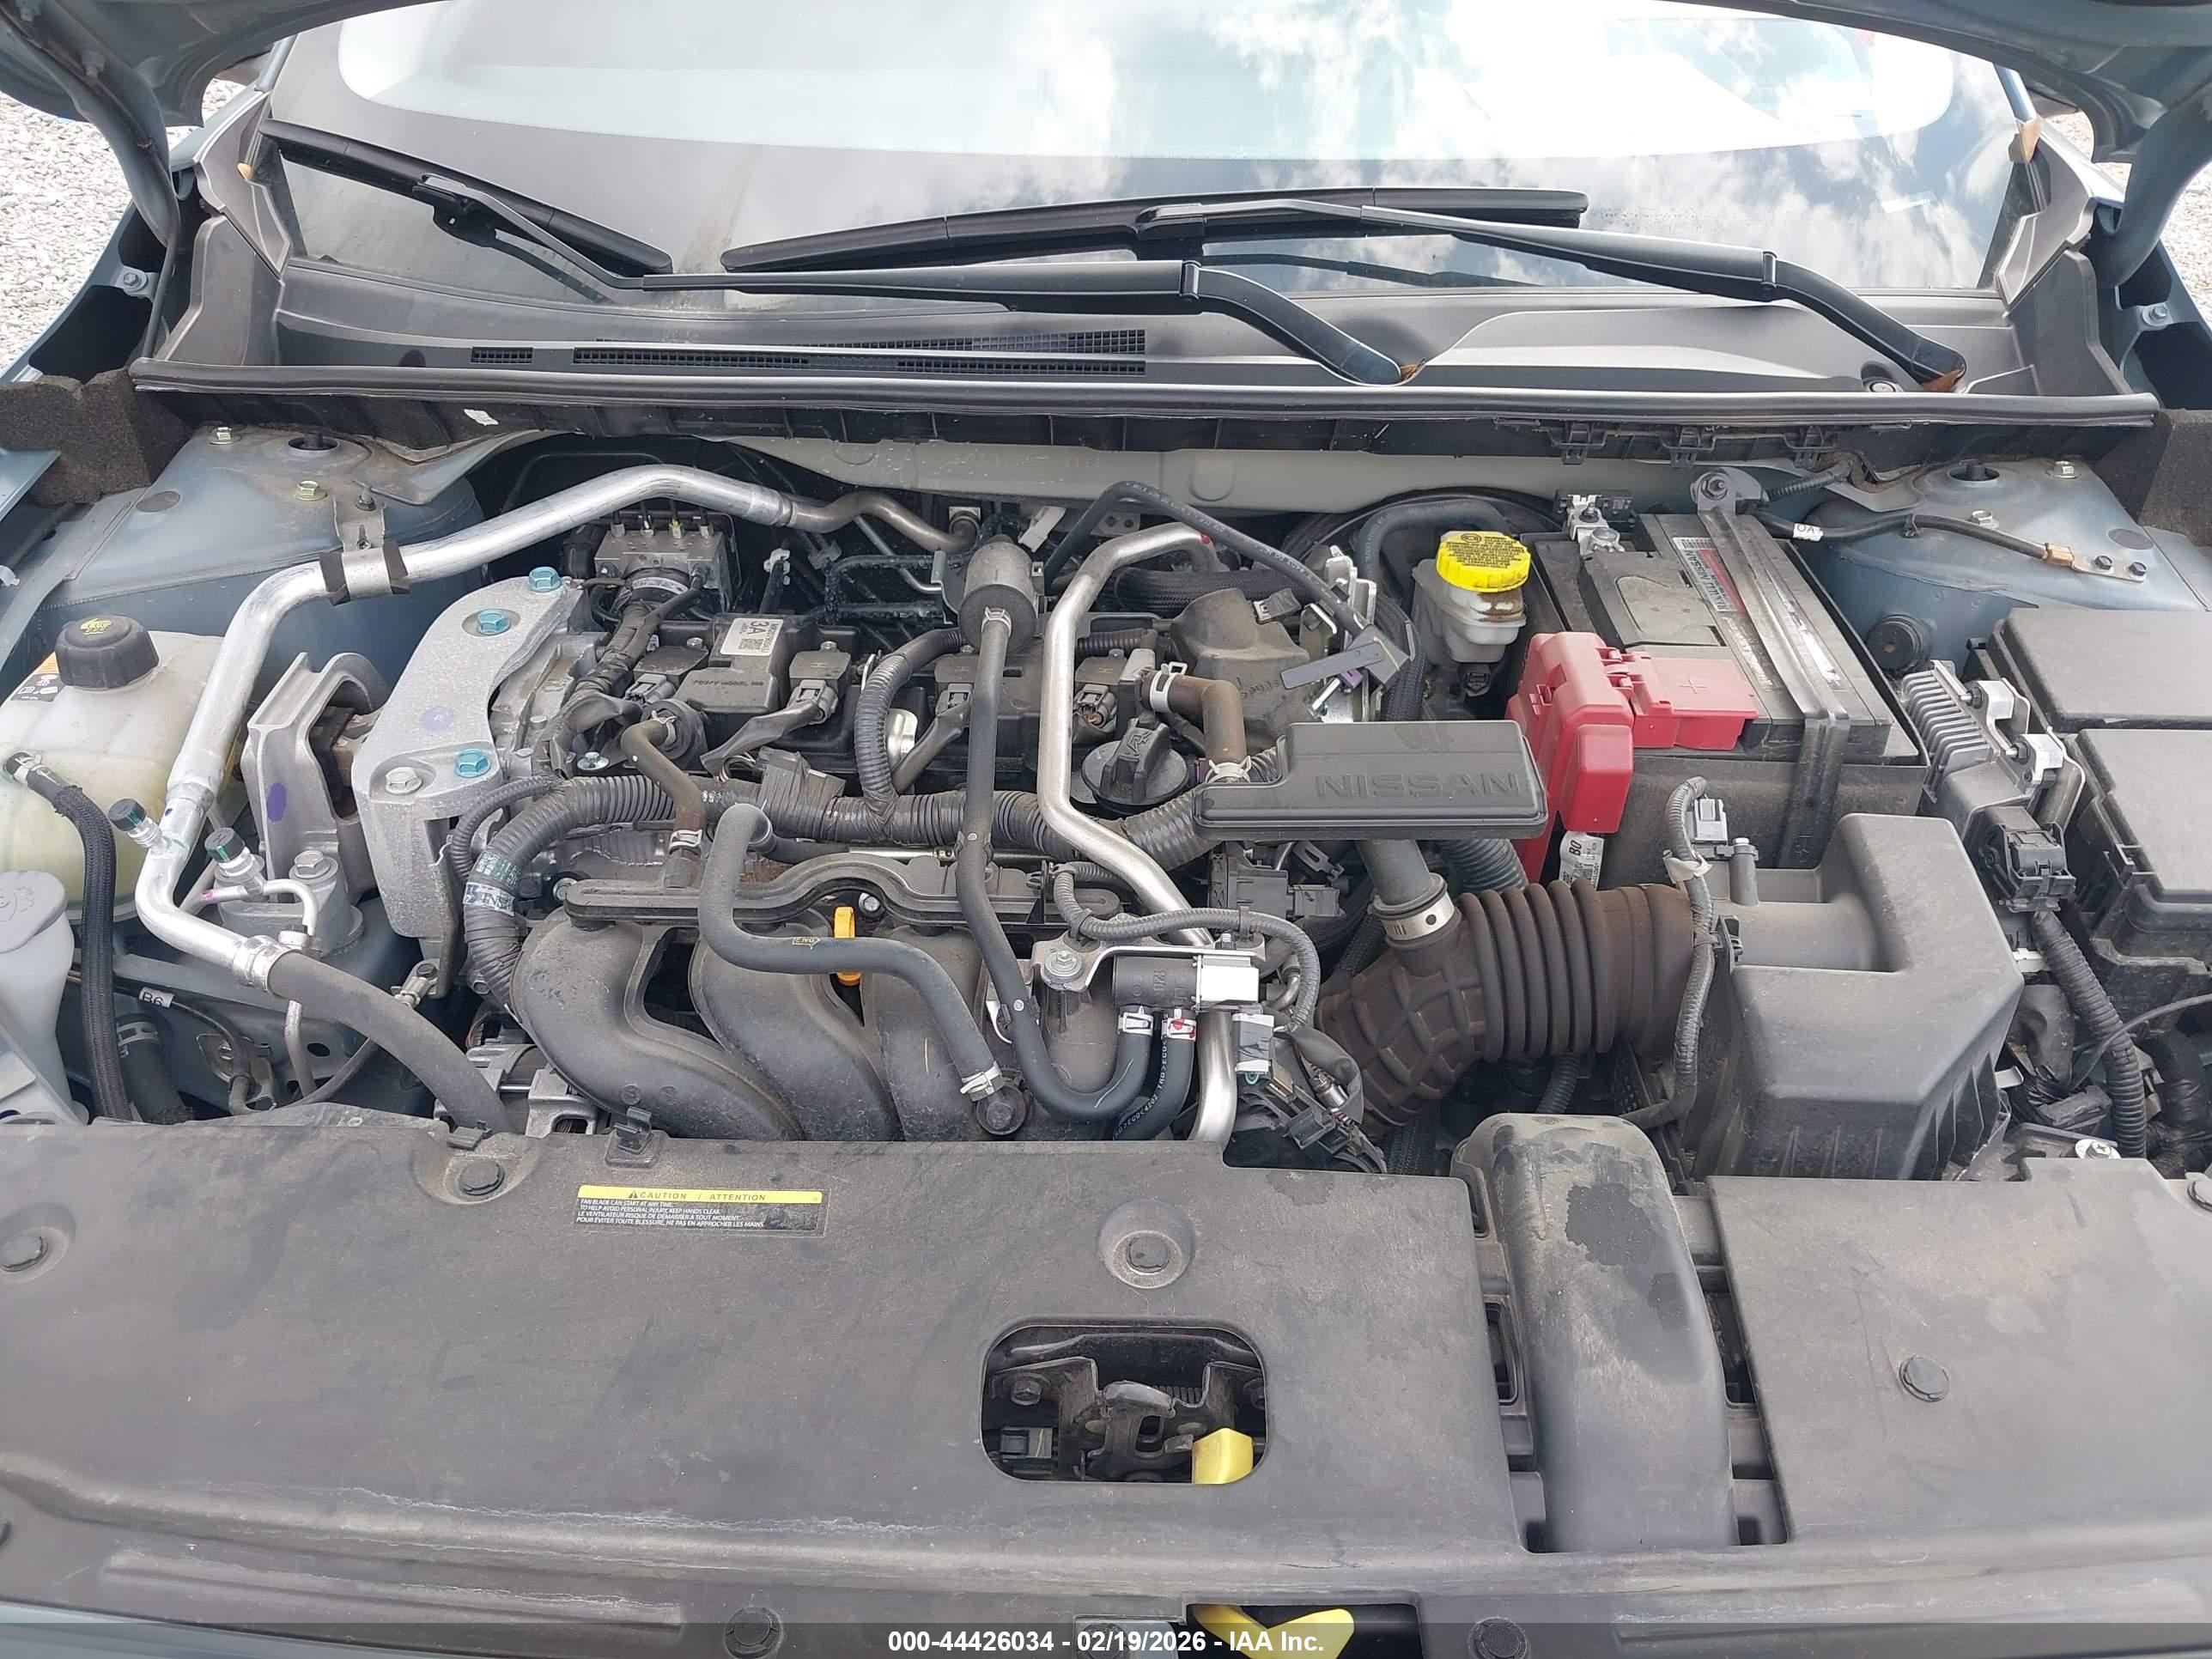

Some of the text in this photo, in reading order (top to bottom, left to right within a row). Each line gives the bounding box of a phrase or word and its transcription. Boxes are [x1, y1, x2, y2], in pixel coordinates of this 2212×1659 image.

[747, 621, 769, 635] 3A
[1315, 773, 1521, 798] NISSAN
[640, 1191, 687, 1200] CAUTION
